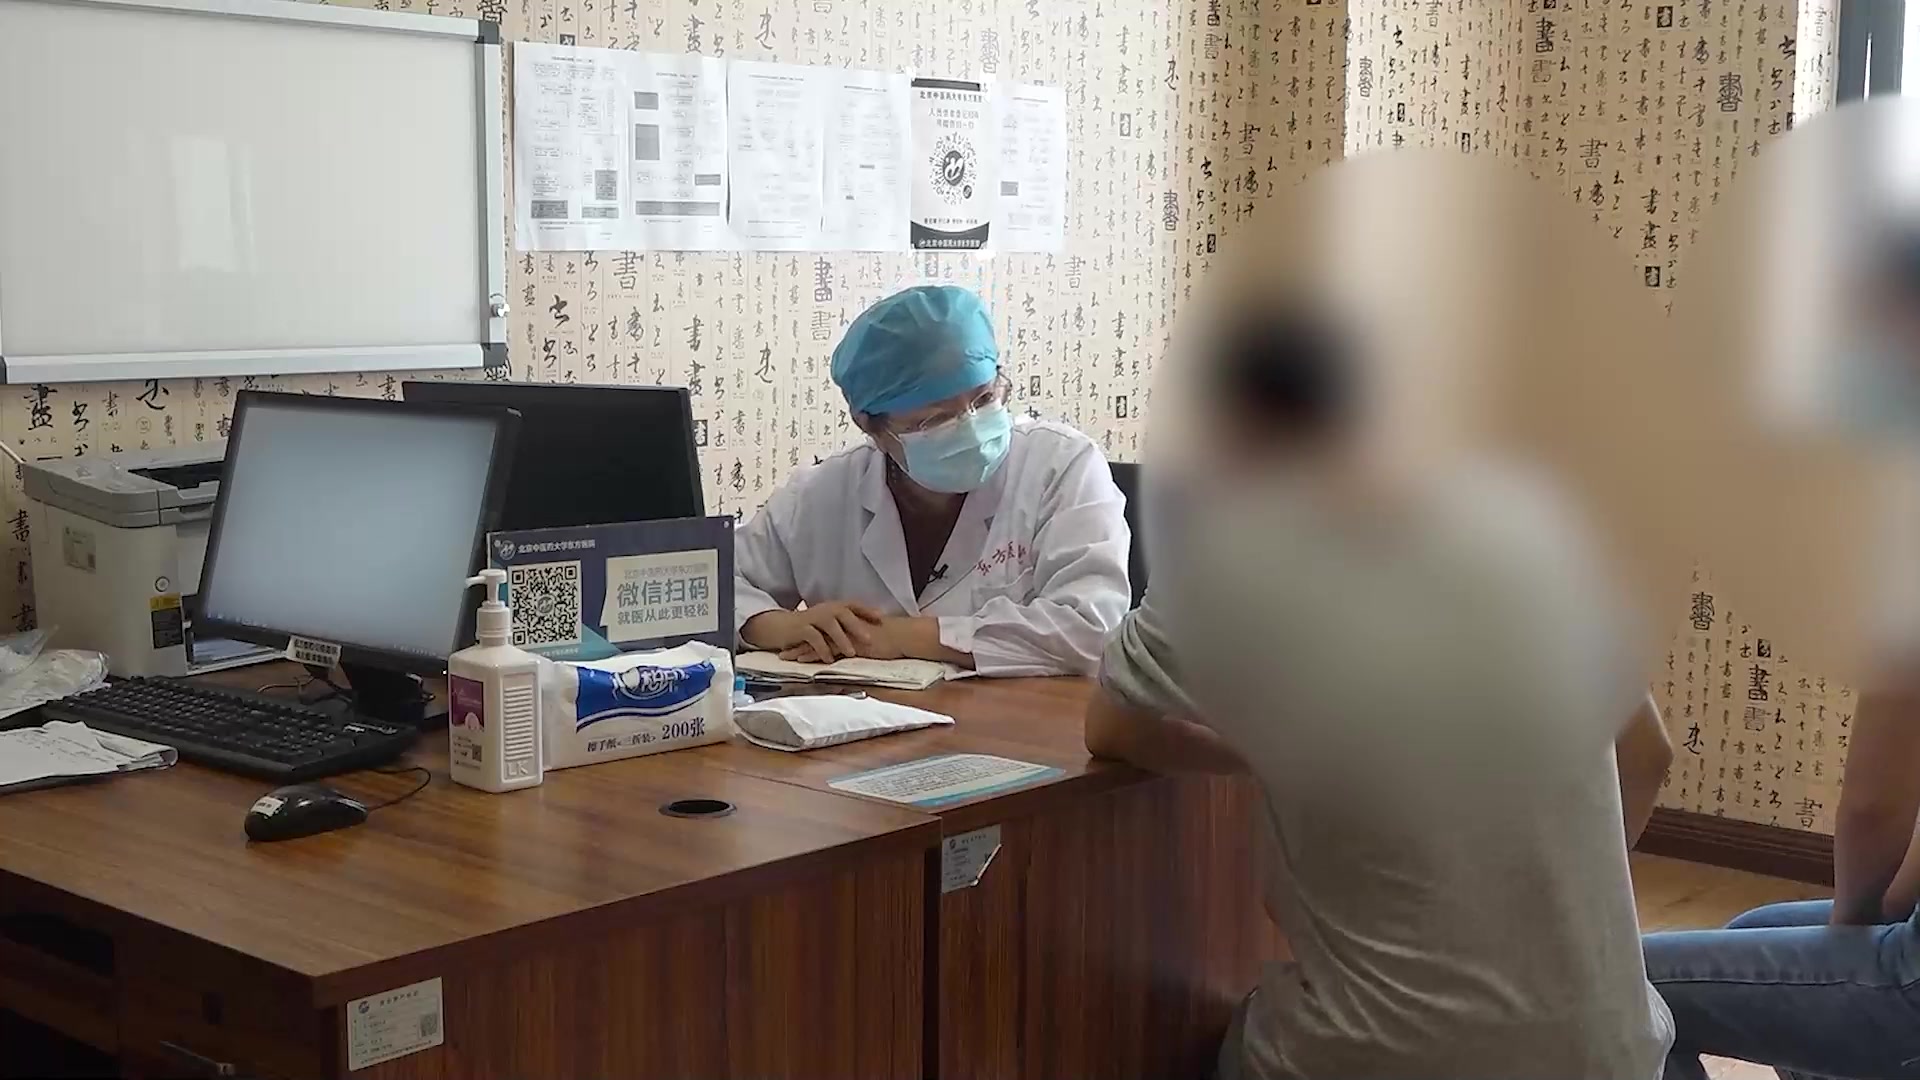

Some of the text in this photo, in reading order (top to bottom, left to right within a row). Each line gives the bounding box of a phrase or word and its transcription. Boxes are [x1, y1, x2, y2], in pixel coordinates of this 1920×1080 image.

[518, 539, 596, 553] 北京中医药大学东方医院
[616, 576, 709, 608] 微信扫码
[617, 604, 709, 625] 就医从此更轻松
[662, 717, 705, 740] 200张
